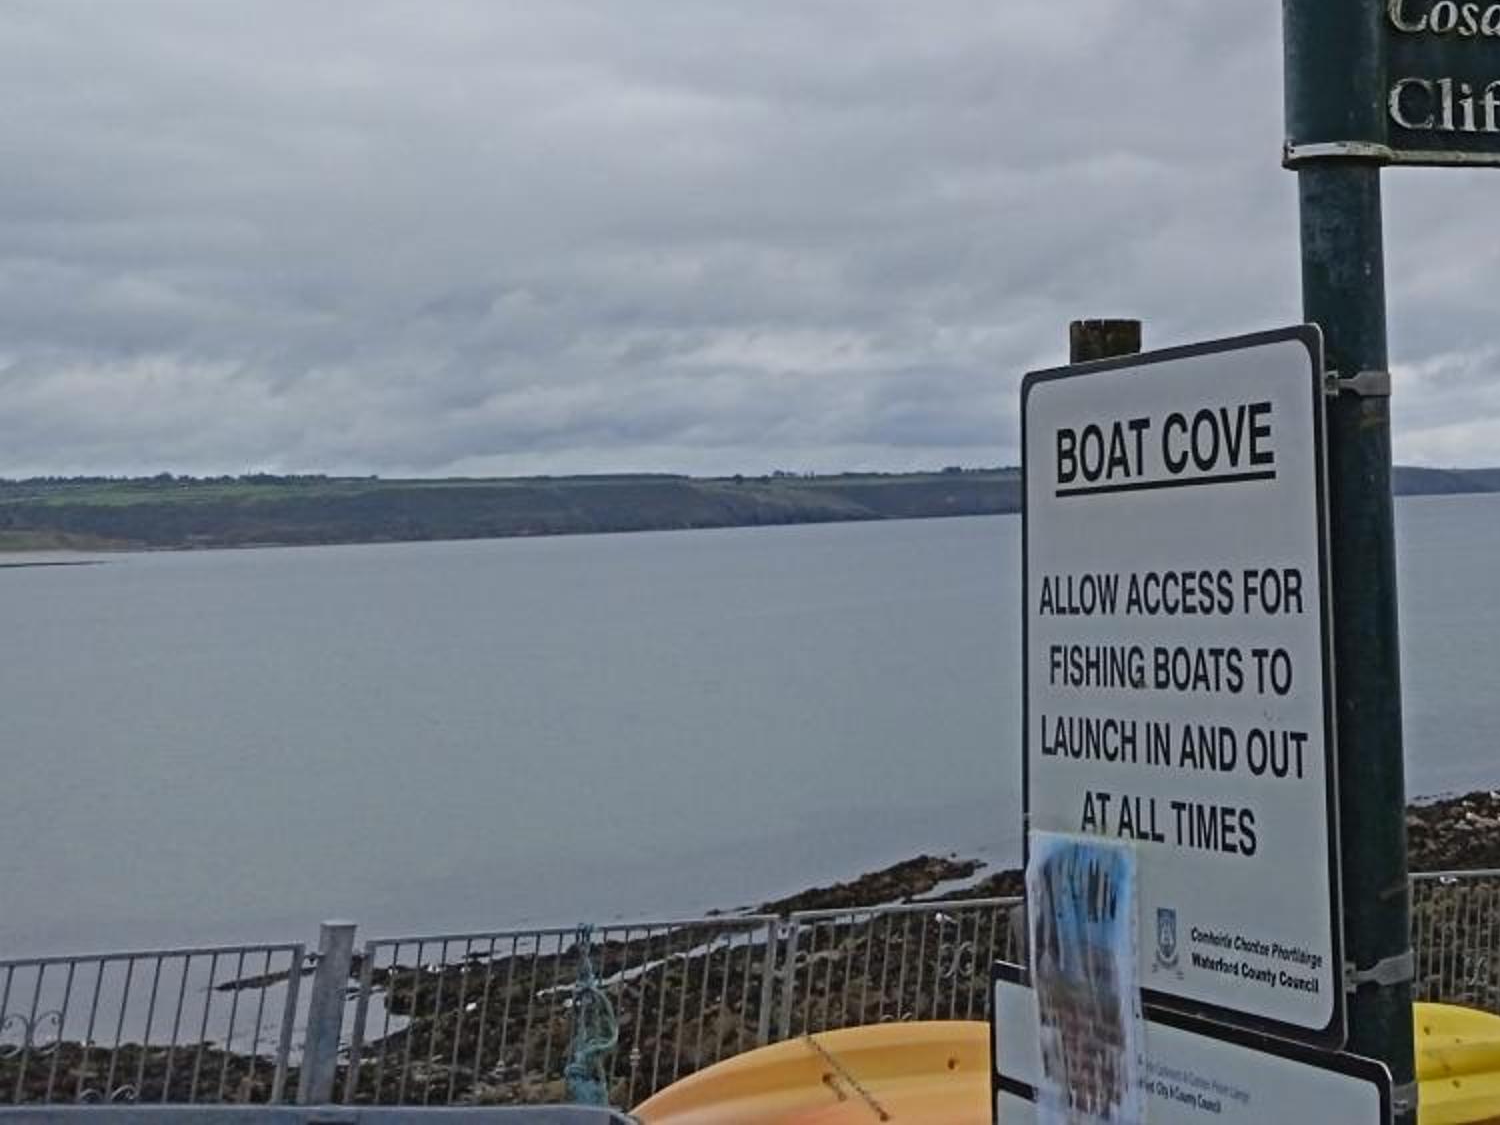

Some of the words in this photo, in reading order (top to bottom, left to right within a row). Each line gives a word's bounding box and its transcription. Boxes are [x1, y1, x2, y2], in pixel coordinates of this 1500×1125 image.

[1056, 418, 1151, 484] BOAT
[1161, 401, 1275, 475] COVE
[1039, 573, 1120, 617] ALLOW
[1126, 569, 1235, 617] ACCESS
[1243, 568, 1303, 615] FOR
[1049, 644, 1146, 690] FISHING
[1153, 646, 1244, 694] BOATS
[1251, 647, 1293, 696] TO
[1041, 714, 1138, 764] LAUNCH
[1146, 721, 1171, 767] IN
[1179, 724, 1238, 773] AND
[1246, 728, 1308, 779] OUT
[1081, 790, 1111, 835] AT
[1118, 795, 1165, 843] ALL
[1171, 800, 1258, 857] TIMES
[1241, 962, 1277, 988] County
[1279, 969, 1320, 994] Council
